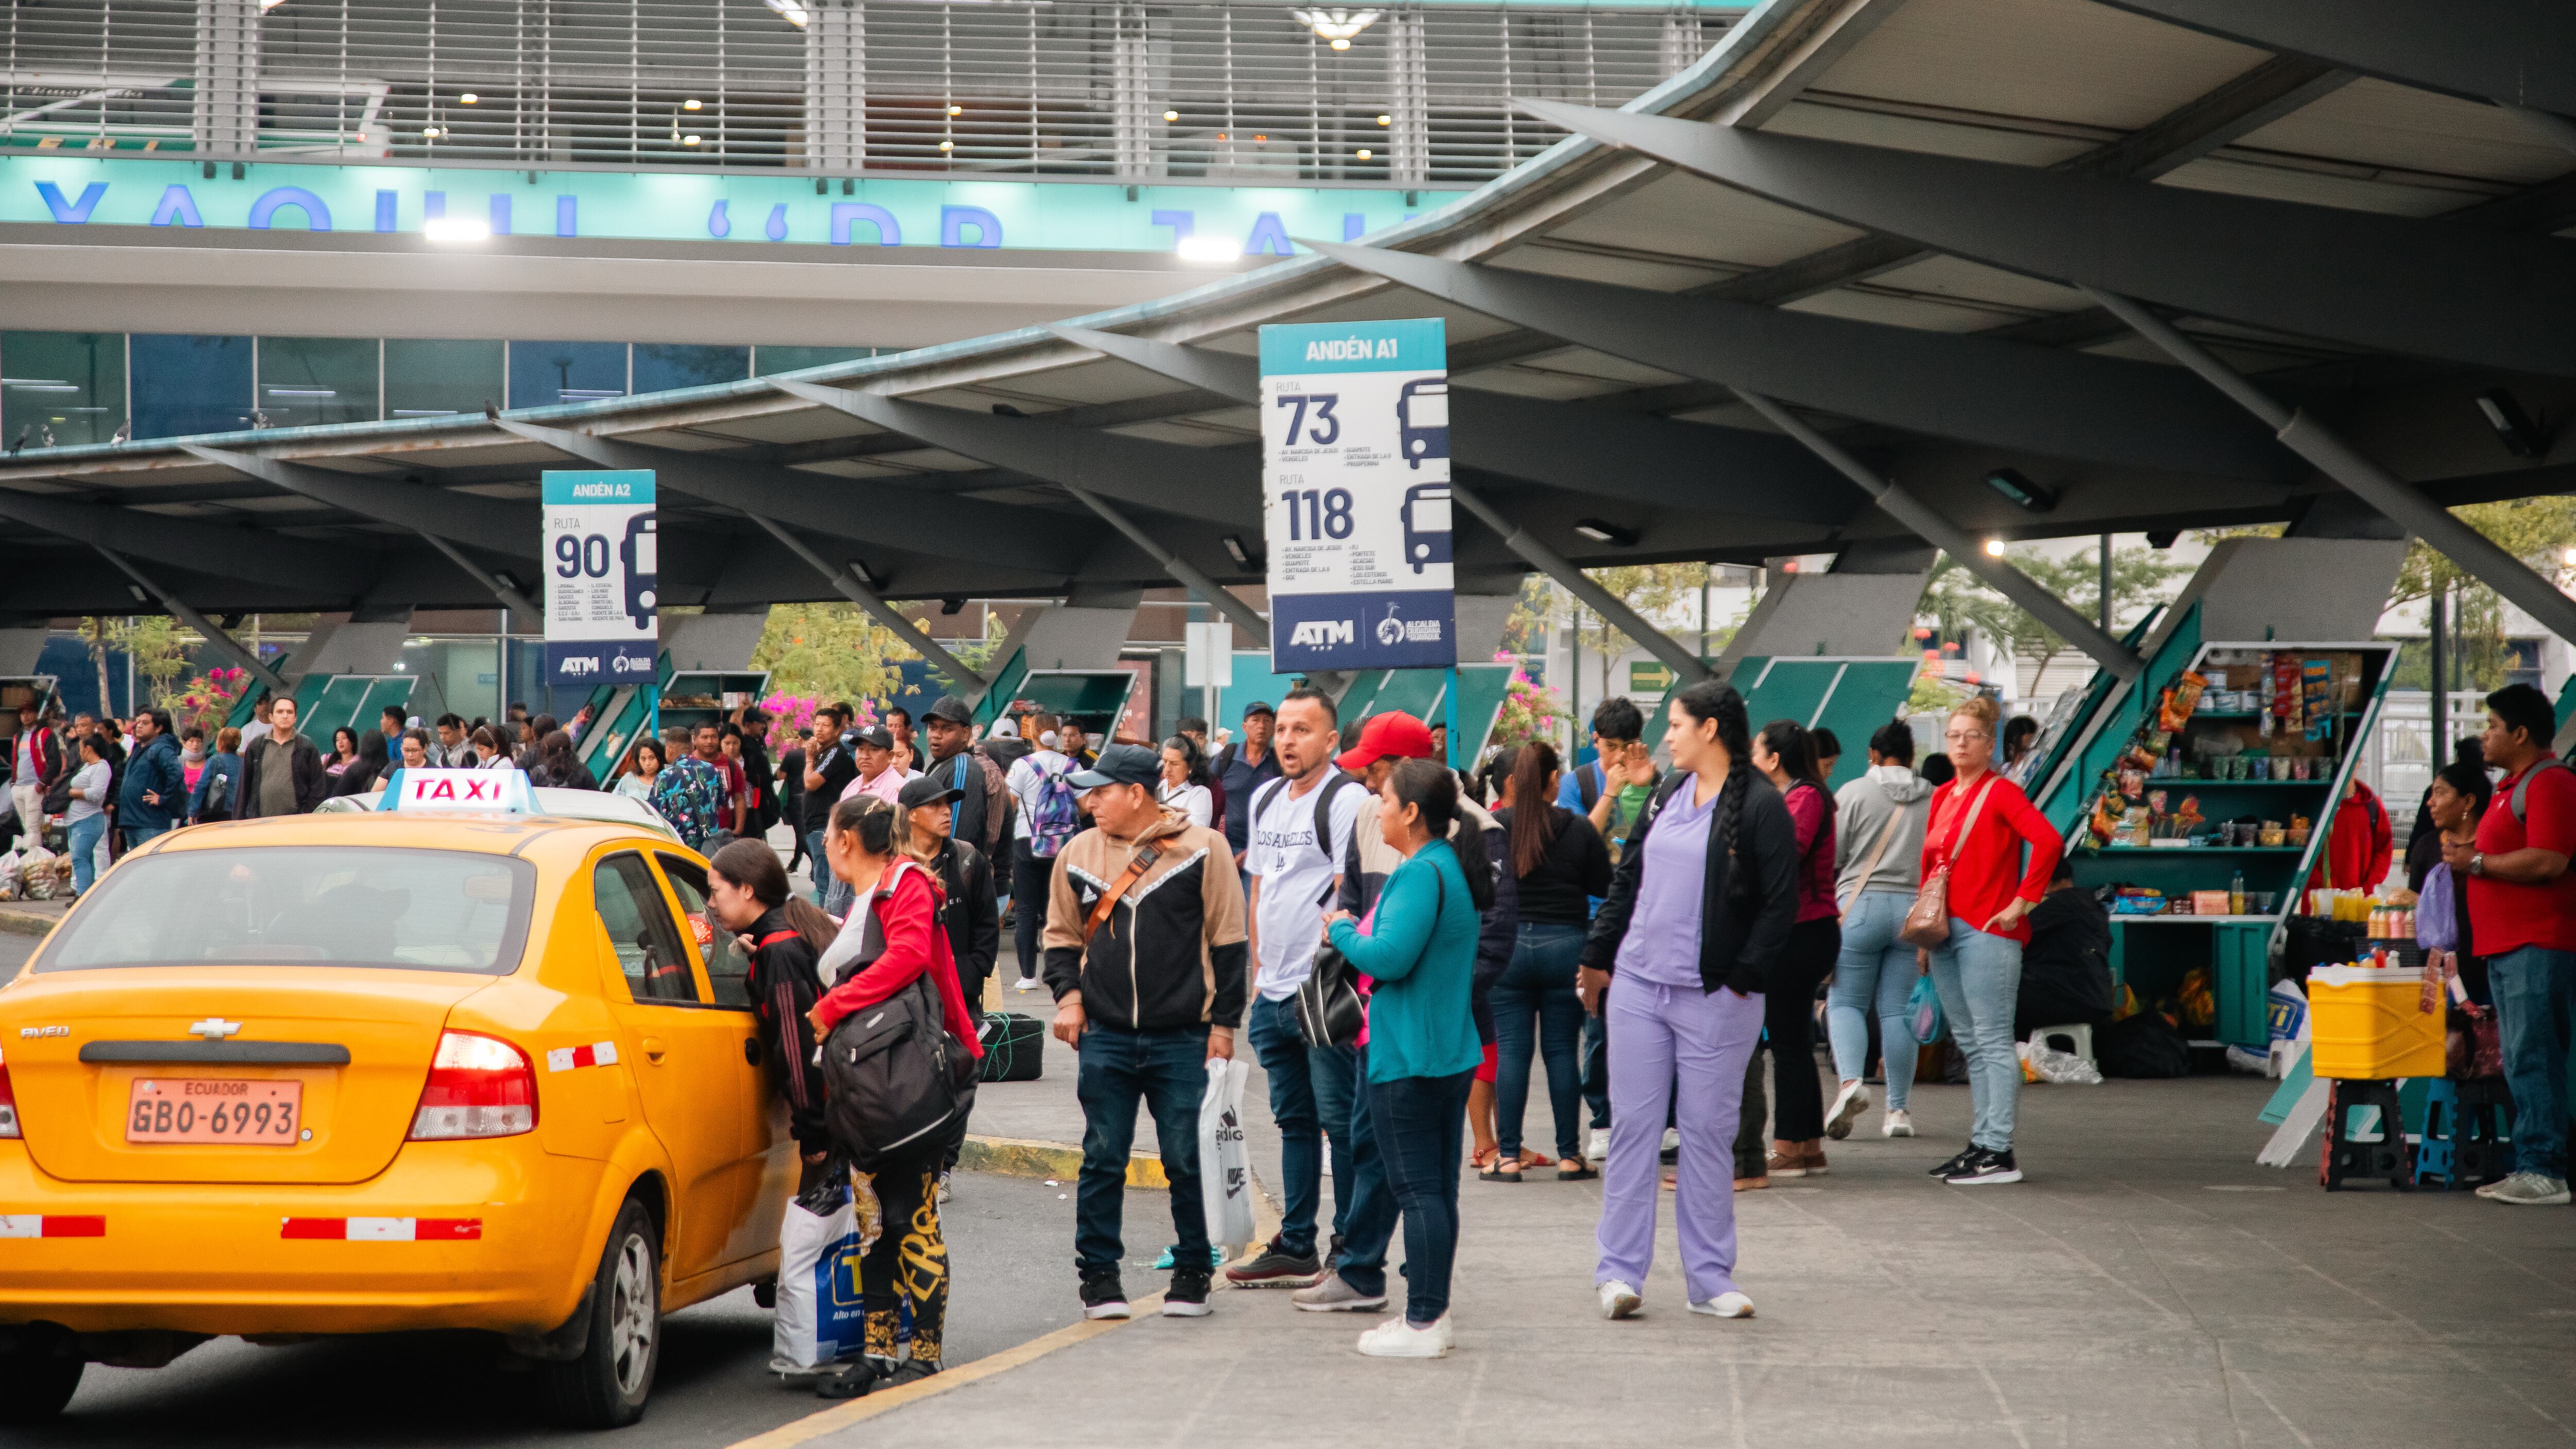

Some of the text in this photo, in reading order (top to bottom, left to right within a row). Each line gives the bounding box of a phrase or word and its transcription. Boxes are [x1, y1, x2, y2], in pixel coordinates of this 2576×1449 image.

[1306, 335, 1397, 361] ANDÉN A1
[1277, 381, 1301, 392] RUTA
[1278, 392, 1341, 446] 73
[1280, 474, 1304, 484] RUTA
[572, 481, 631, 497] ANDÉN A2
[1282, 486, 1355, 540] 118
[554, 518, 581, 529] RUTA
[556, 534, 610, 578] 90
[1291, 620, 1354, 645] ATM
[560, 656, 599, 672] ATM
[411, 778, 502, 800] TAXI
[1257, 830, 1273, 845] LOS
[21, 1025, 70, 1040] AVEO
[185, 1082, 249, 1097] ECUADOR
[833, 1310, 849, 1321] Alto
